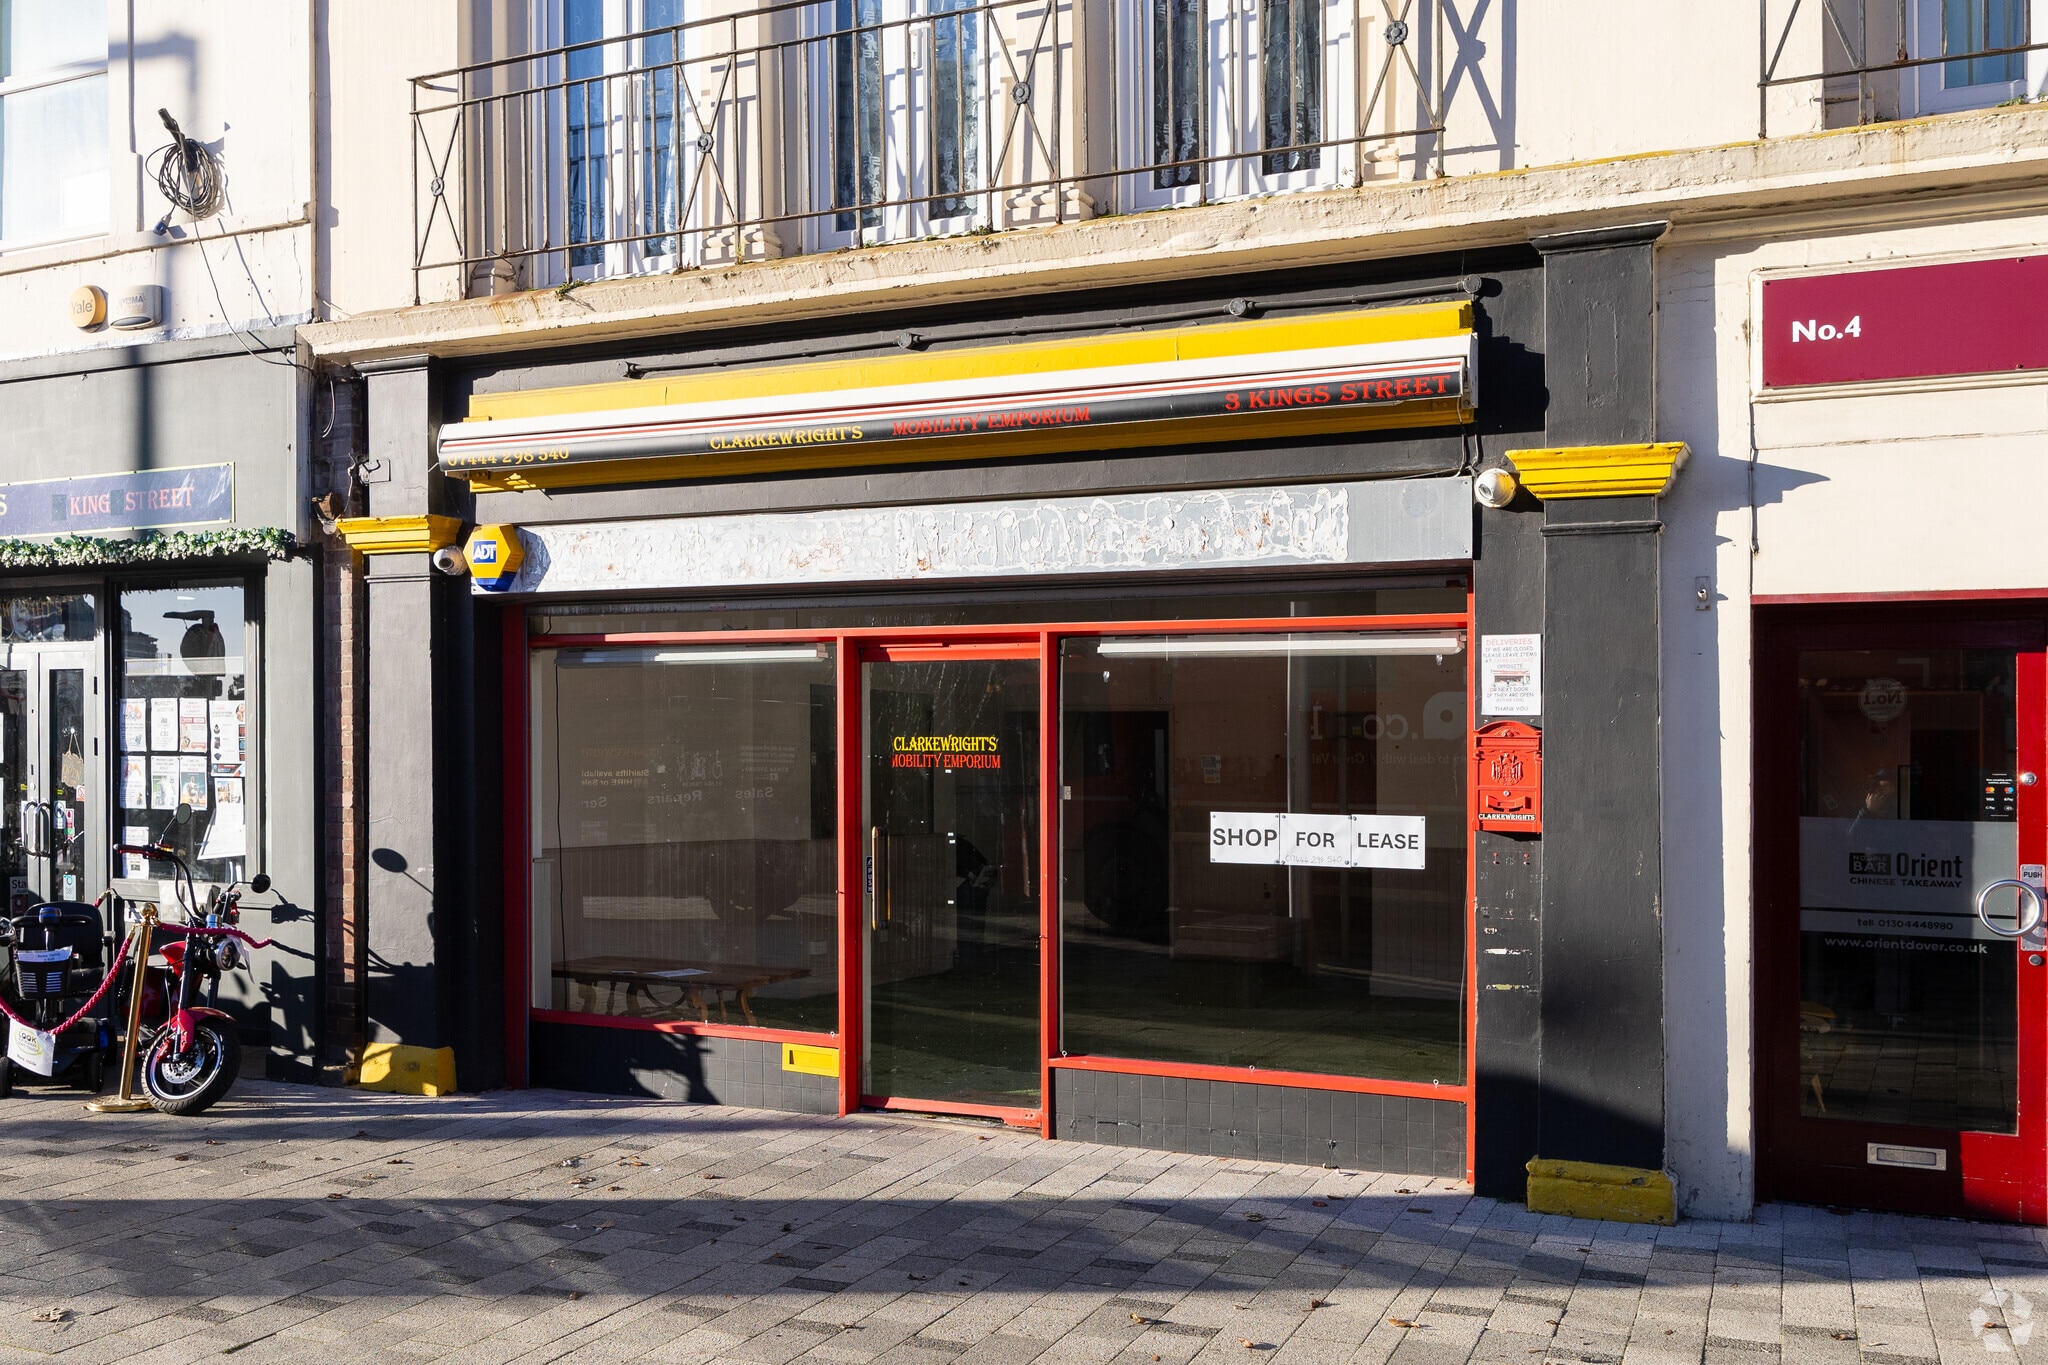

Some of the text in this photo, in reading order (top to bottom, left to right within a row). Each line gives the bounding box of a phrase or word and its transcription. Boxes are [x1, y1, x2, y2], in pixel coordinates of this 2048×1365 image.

[70, 300, 93, 315] Yale
[1792, 315, 1862, 343] No.4
[1224, 374, 1452, 411] 3 KINGS STREET
[892, 406, 1090, 437] MOBILITY EMPORIUM
[710, 424, 864, 450] CLARKEWRIGHT'S
[447, 446, 570, 467] 07444 298 540
[69, 486, 194, 516] KING STREET
[473, 543, 497, 560] ADT
[1486, 638, 1533, 646] DELIVERIES
[893, 734, 998, 753] CLARKEWRIGHT'S
[891, 752, 1001, 769] MOBILITY EMPORIUM
[1212, 828, 1278, 847] SHOP
[1295, 831, 1335, 848] FOR
[1357, 832, 1419, 850] LEASE
[1853, 862, 1887, 873] BAR
[1896, 852, 1963, 878] Orient
[1850, 877, 1962, 888] CHINESE TAKEAWAY
[2023, 870, 2043, 879] PUSH
[1857, 918, 1874, 927] tel:
[1824, 937, 1988, 954] www.orientdover.co.uk
